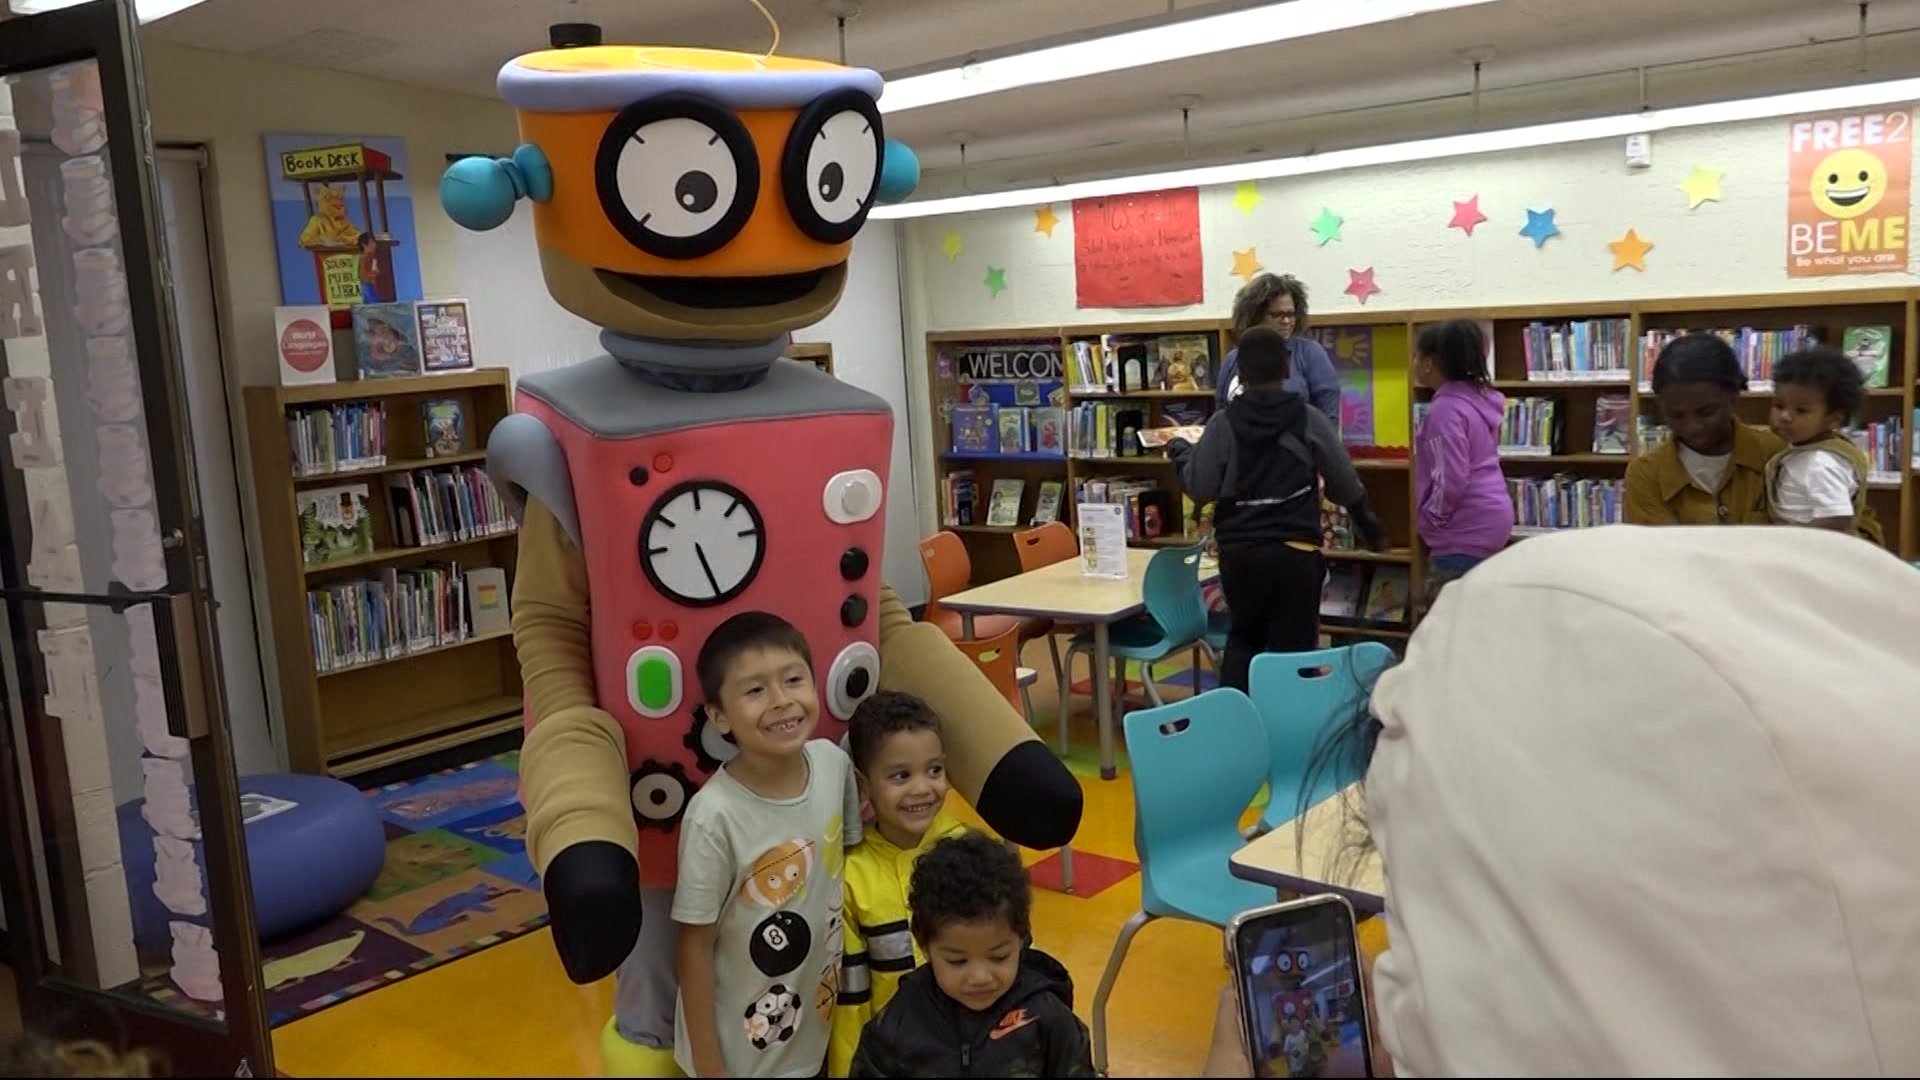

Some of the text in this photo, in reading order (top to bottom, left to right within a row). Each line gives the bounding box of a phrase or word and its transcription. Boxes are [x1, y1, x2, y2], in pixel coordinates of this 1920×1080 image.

[1792, 111, 1909, 152] FREE2
[327, 151, 360, 168] DESK
[1795, 256, 1812, 267] Be
[1814, 255, 1845, 265] what
[1846, 255, 1872, 265] you
[768, 928, 784, 945] 8
